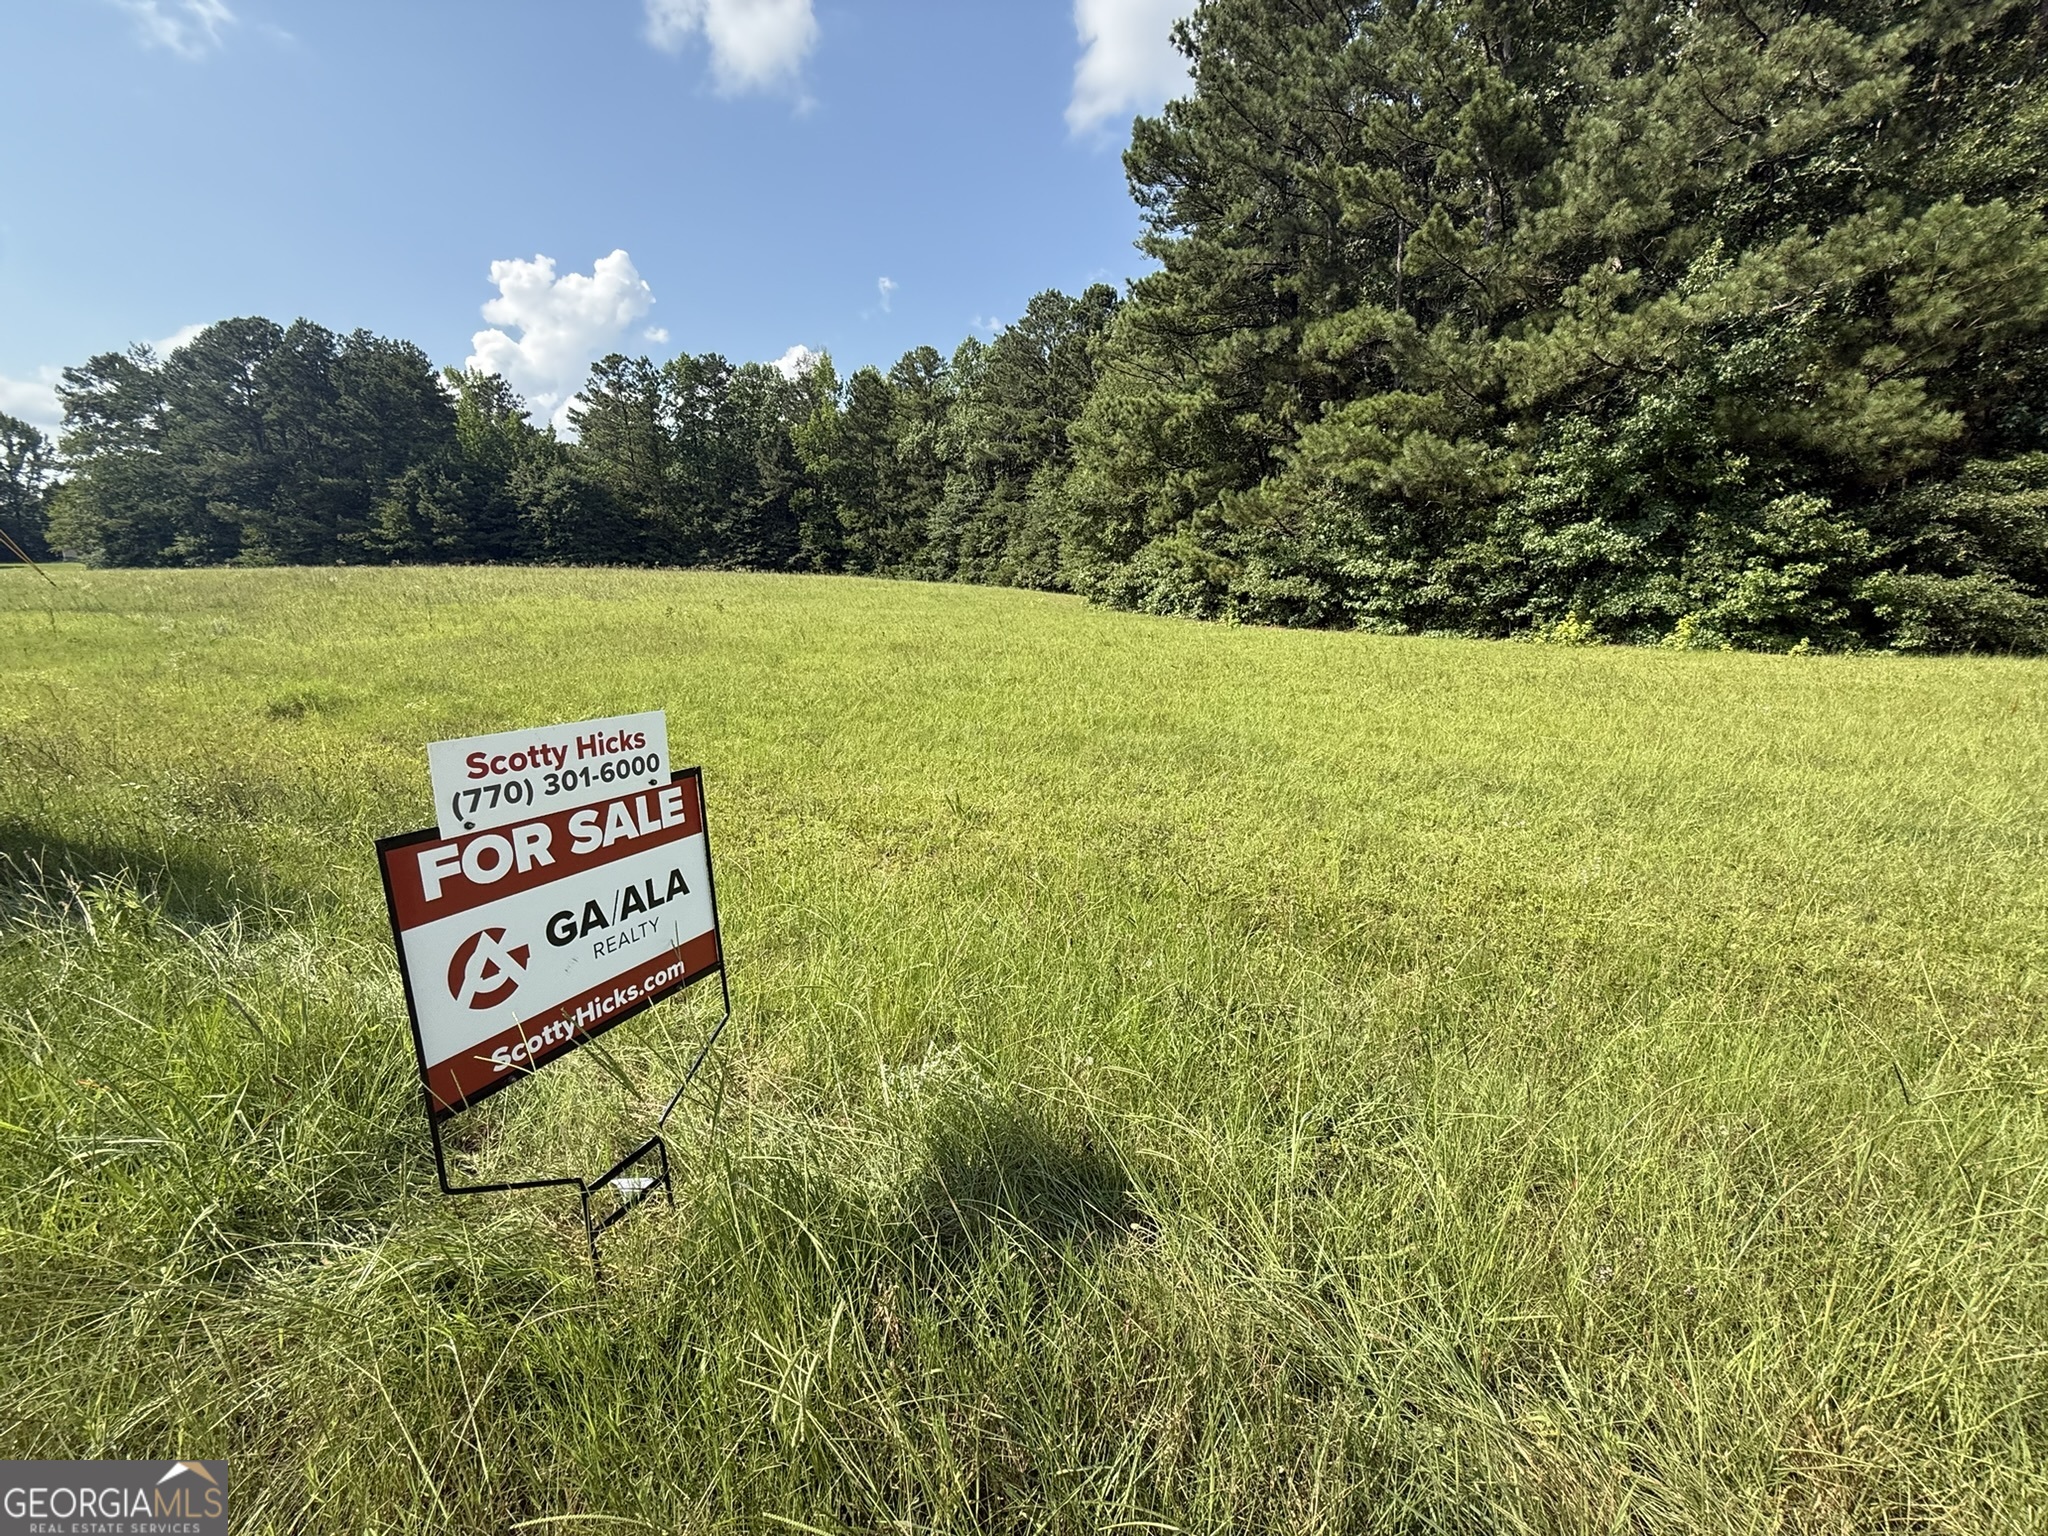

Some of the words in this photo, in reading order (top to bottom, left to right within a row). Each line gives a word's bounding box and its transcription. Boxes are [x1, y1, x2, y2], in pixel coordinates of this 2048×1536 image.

[452, 778, 534, 822] (770)
[543, 752, 660, 797] 301-6000
[466, 744, 568, 780] Scotty
[576, 730, 647, 760] Hicks
[417, 822, 556, 903] FOR
[567, 786, 686, 855] SALE
[545, 868, 691, 948] GA/ALA
[592, 916, 661, 960] REALTY
[490, 959, 686, 1073] ScottyHicks.com
